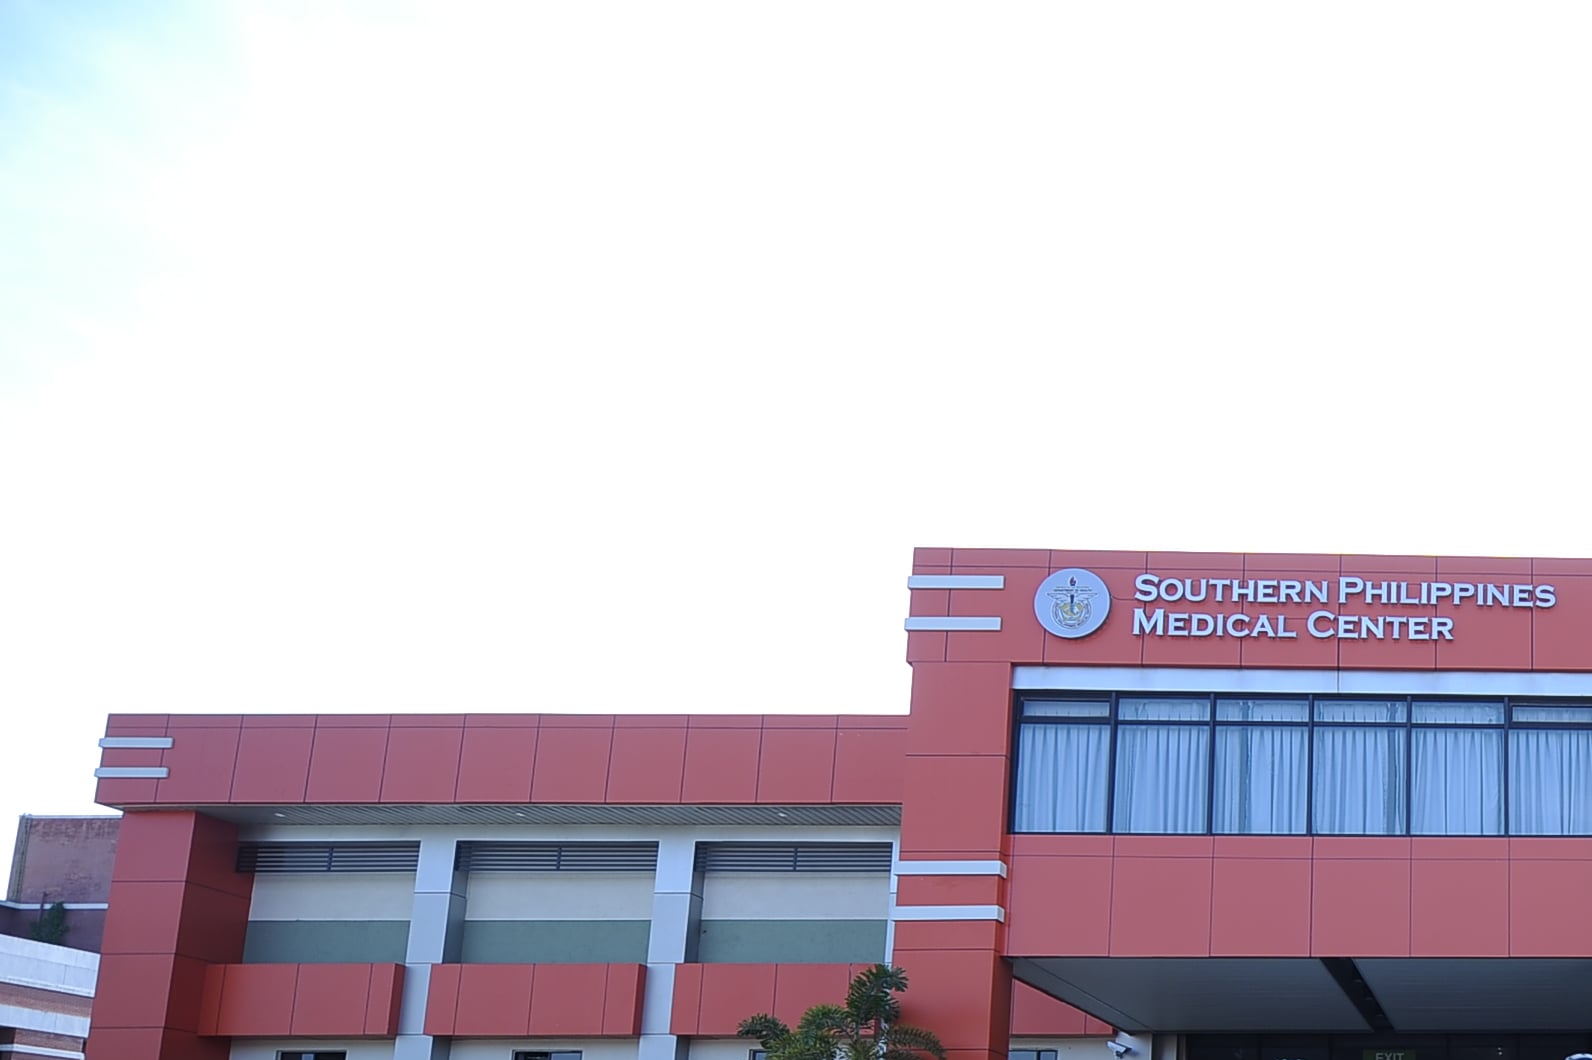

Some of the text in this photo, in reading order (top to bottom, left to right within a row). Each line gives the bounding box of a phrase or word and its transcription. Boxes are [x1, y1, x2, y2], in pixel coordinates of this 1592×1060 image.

[1134, 573, 1557, 608] SOUTHERN PHILIPPINES
[1132, 607, 1455, 641] MEDICAL CENTER
